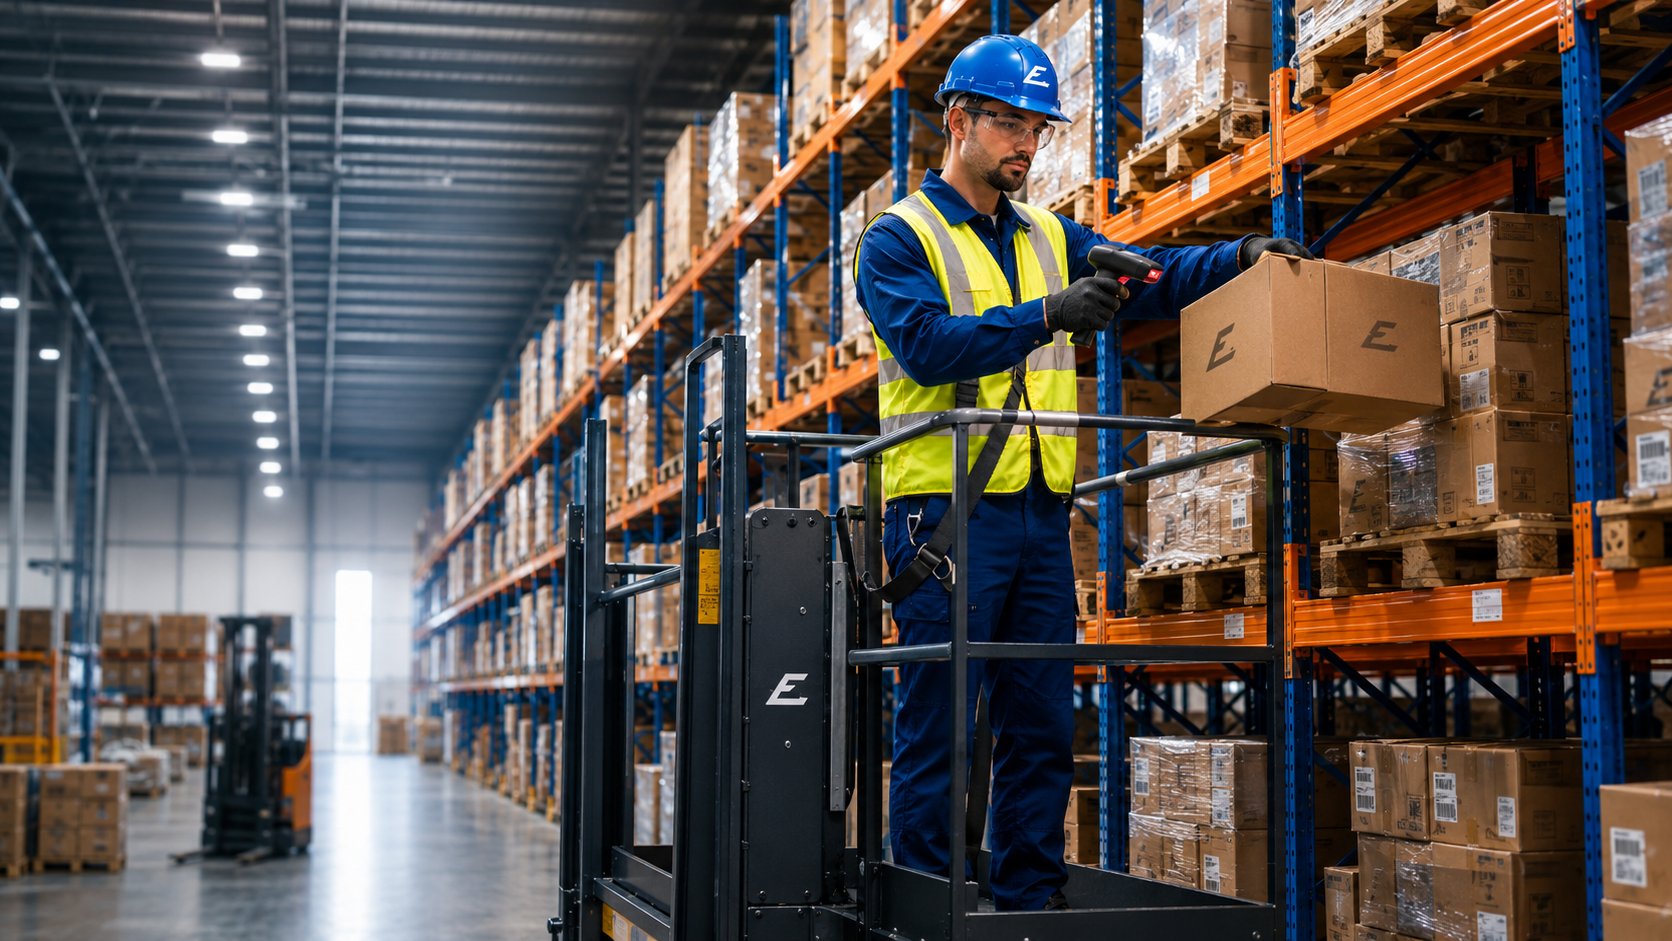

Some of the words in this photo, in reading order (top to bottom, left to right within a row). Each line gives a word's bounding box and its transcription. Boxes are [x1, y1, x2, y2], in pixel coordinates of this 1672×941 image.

[1023, 65, 1050, 88] E
[1206, 322, 1236, 373] E
[1361, 320, 1398, 352] E
[765, 673, 808, 705] E
